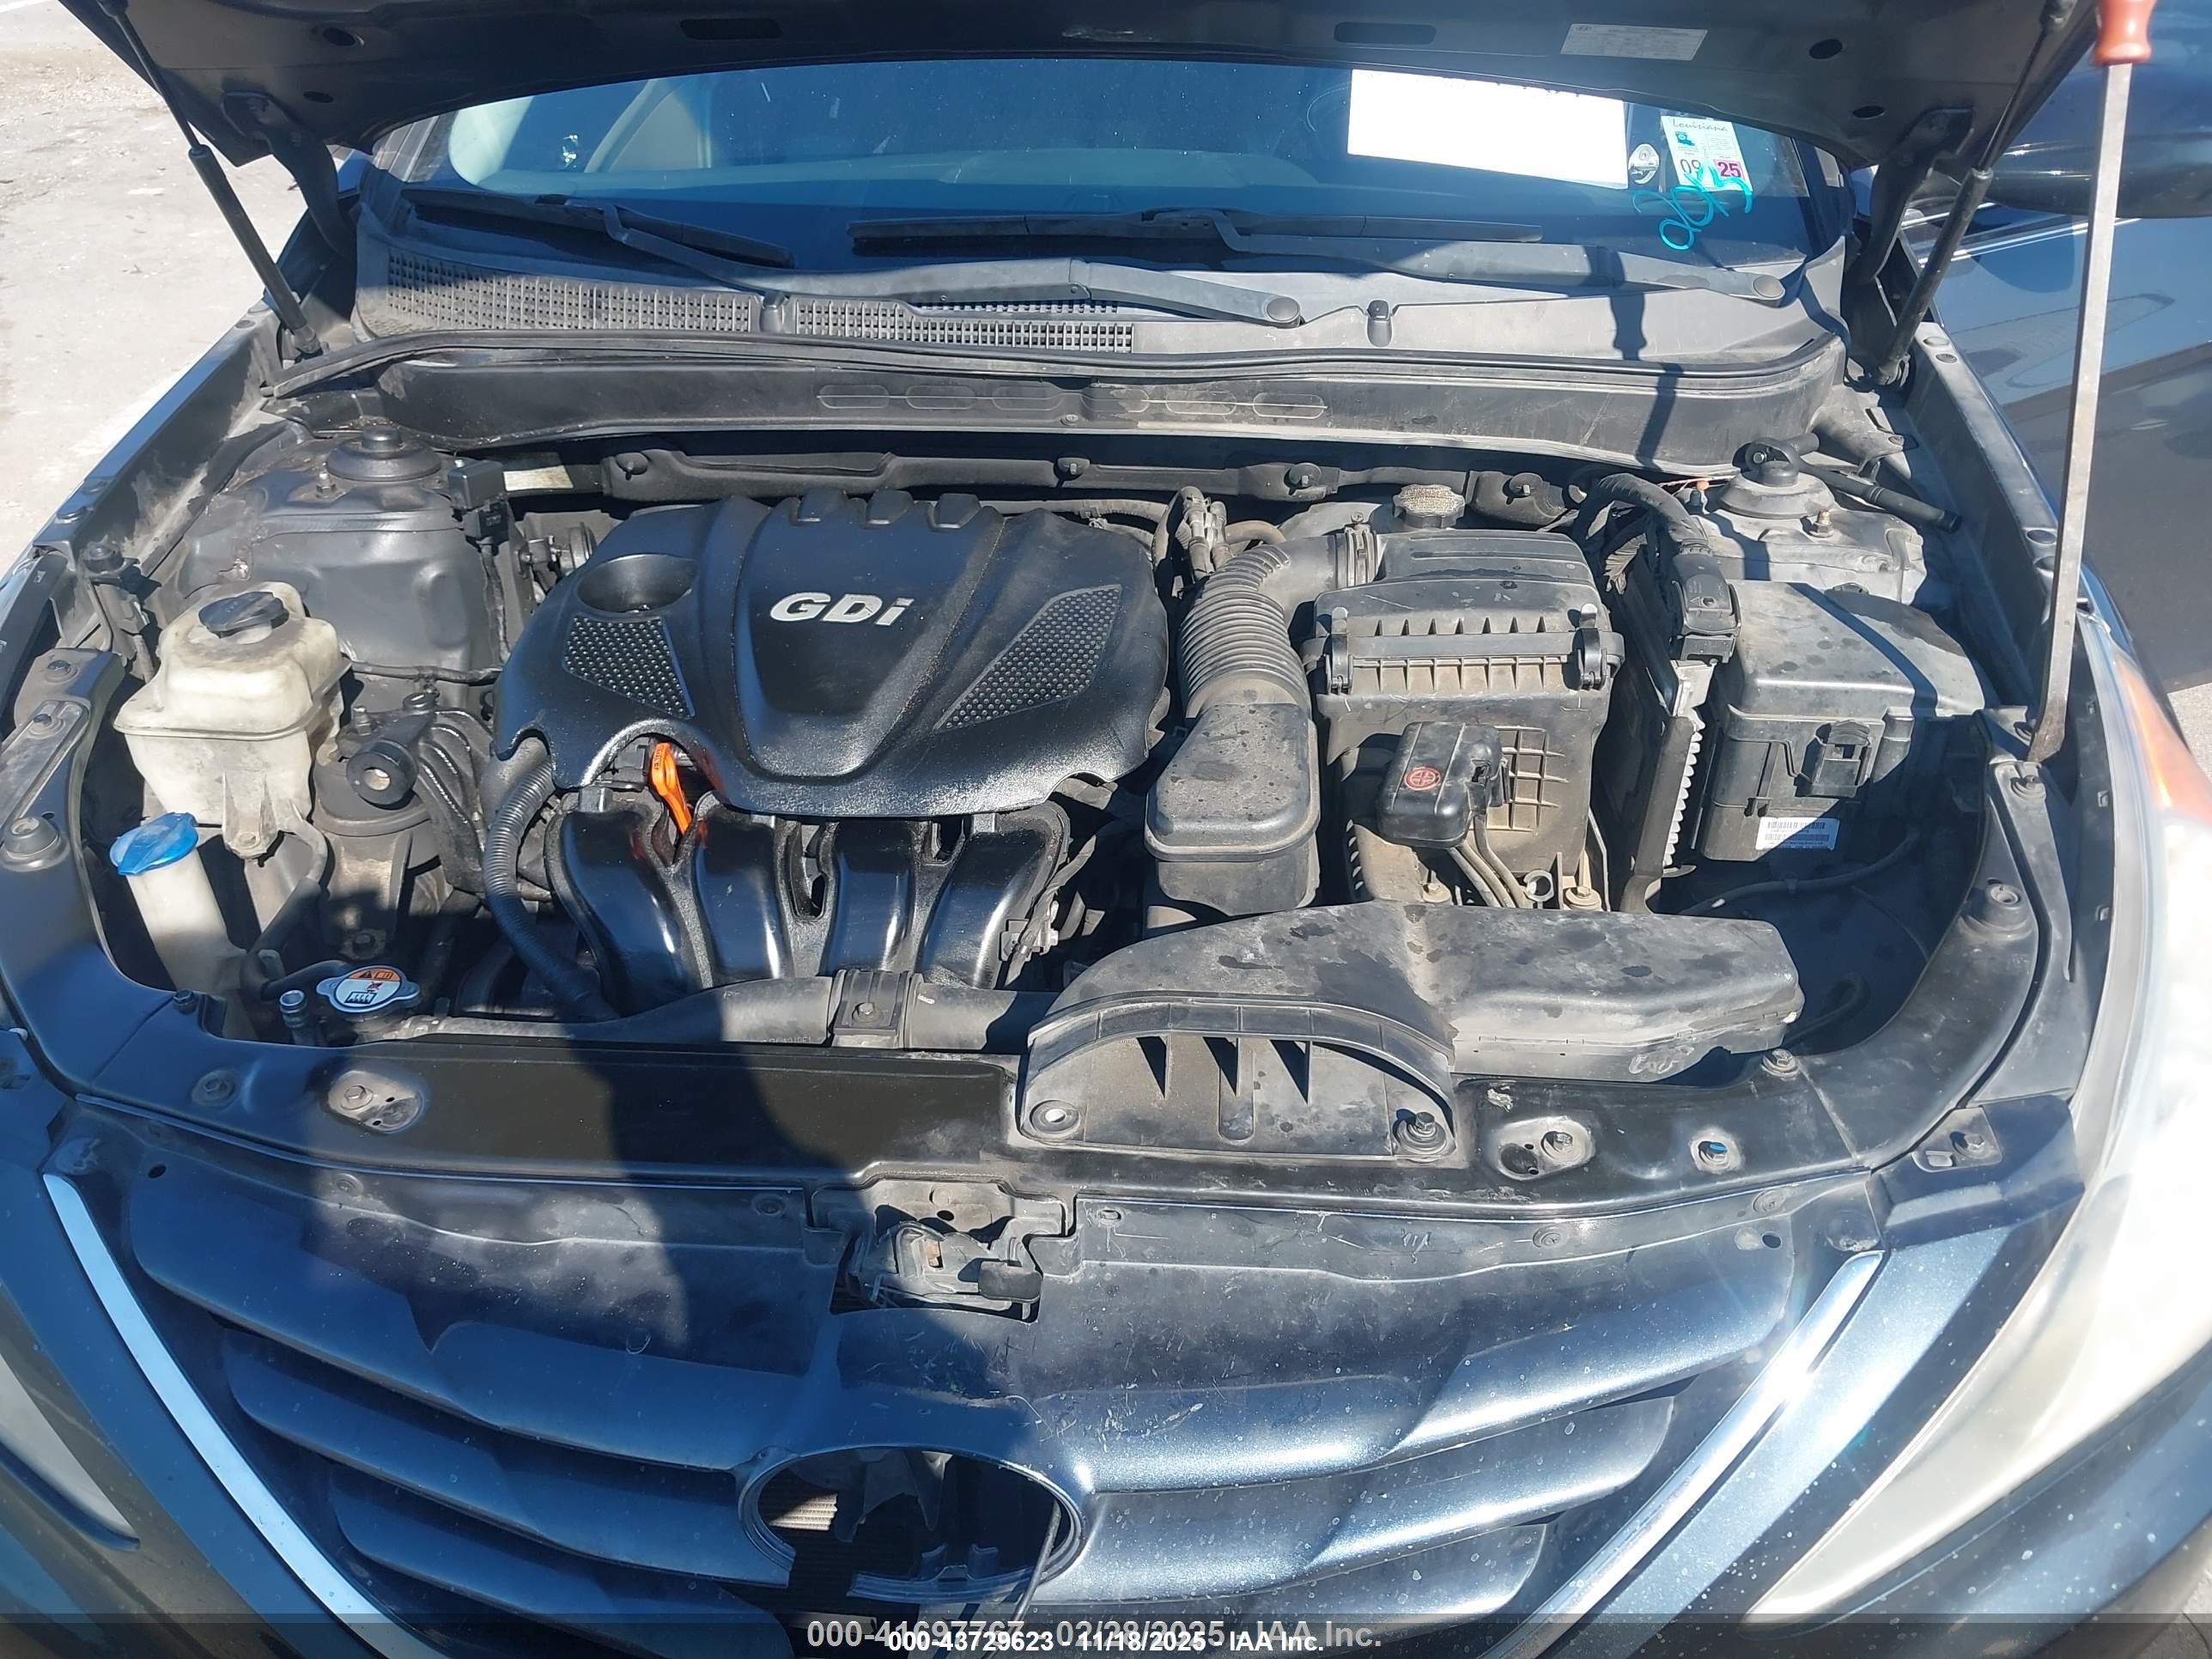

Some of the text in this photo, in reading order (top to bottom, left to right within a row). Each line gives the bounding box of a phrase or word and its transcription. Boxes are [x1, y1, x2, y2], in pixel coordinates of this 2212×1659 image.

[1680, 158, 1704, 179] 09
[1717, 161, 1742, 179] 25
[769, 592, 915, 626] GDi
